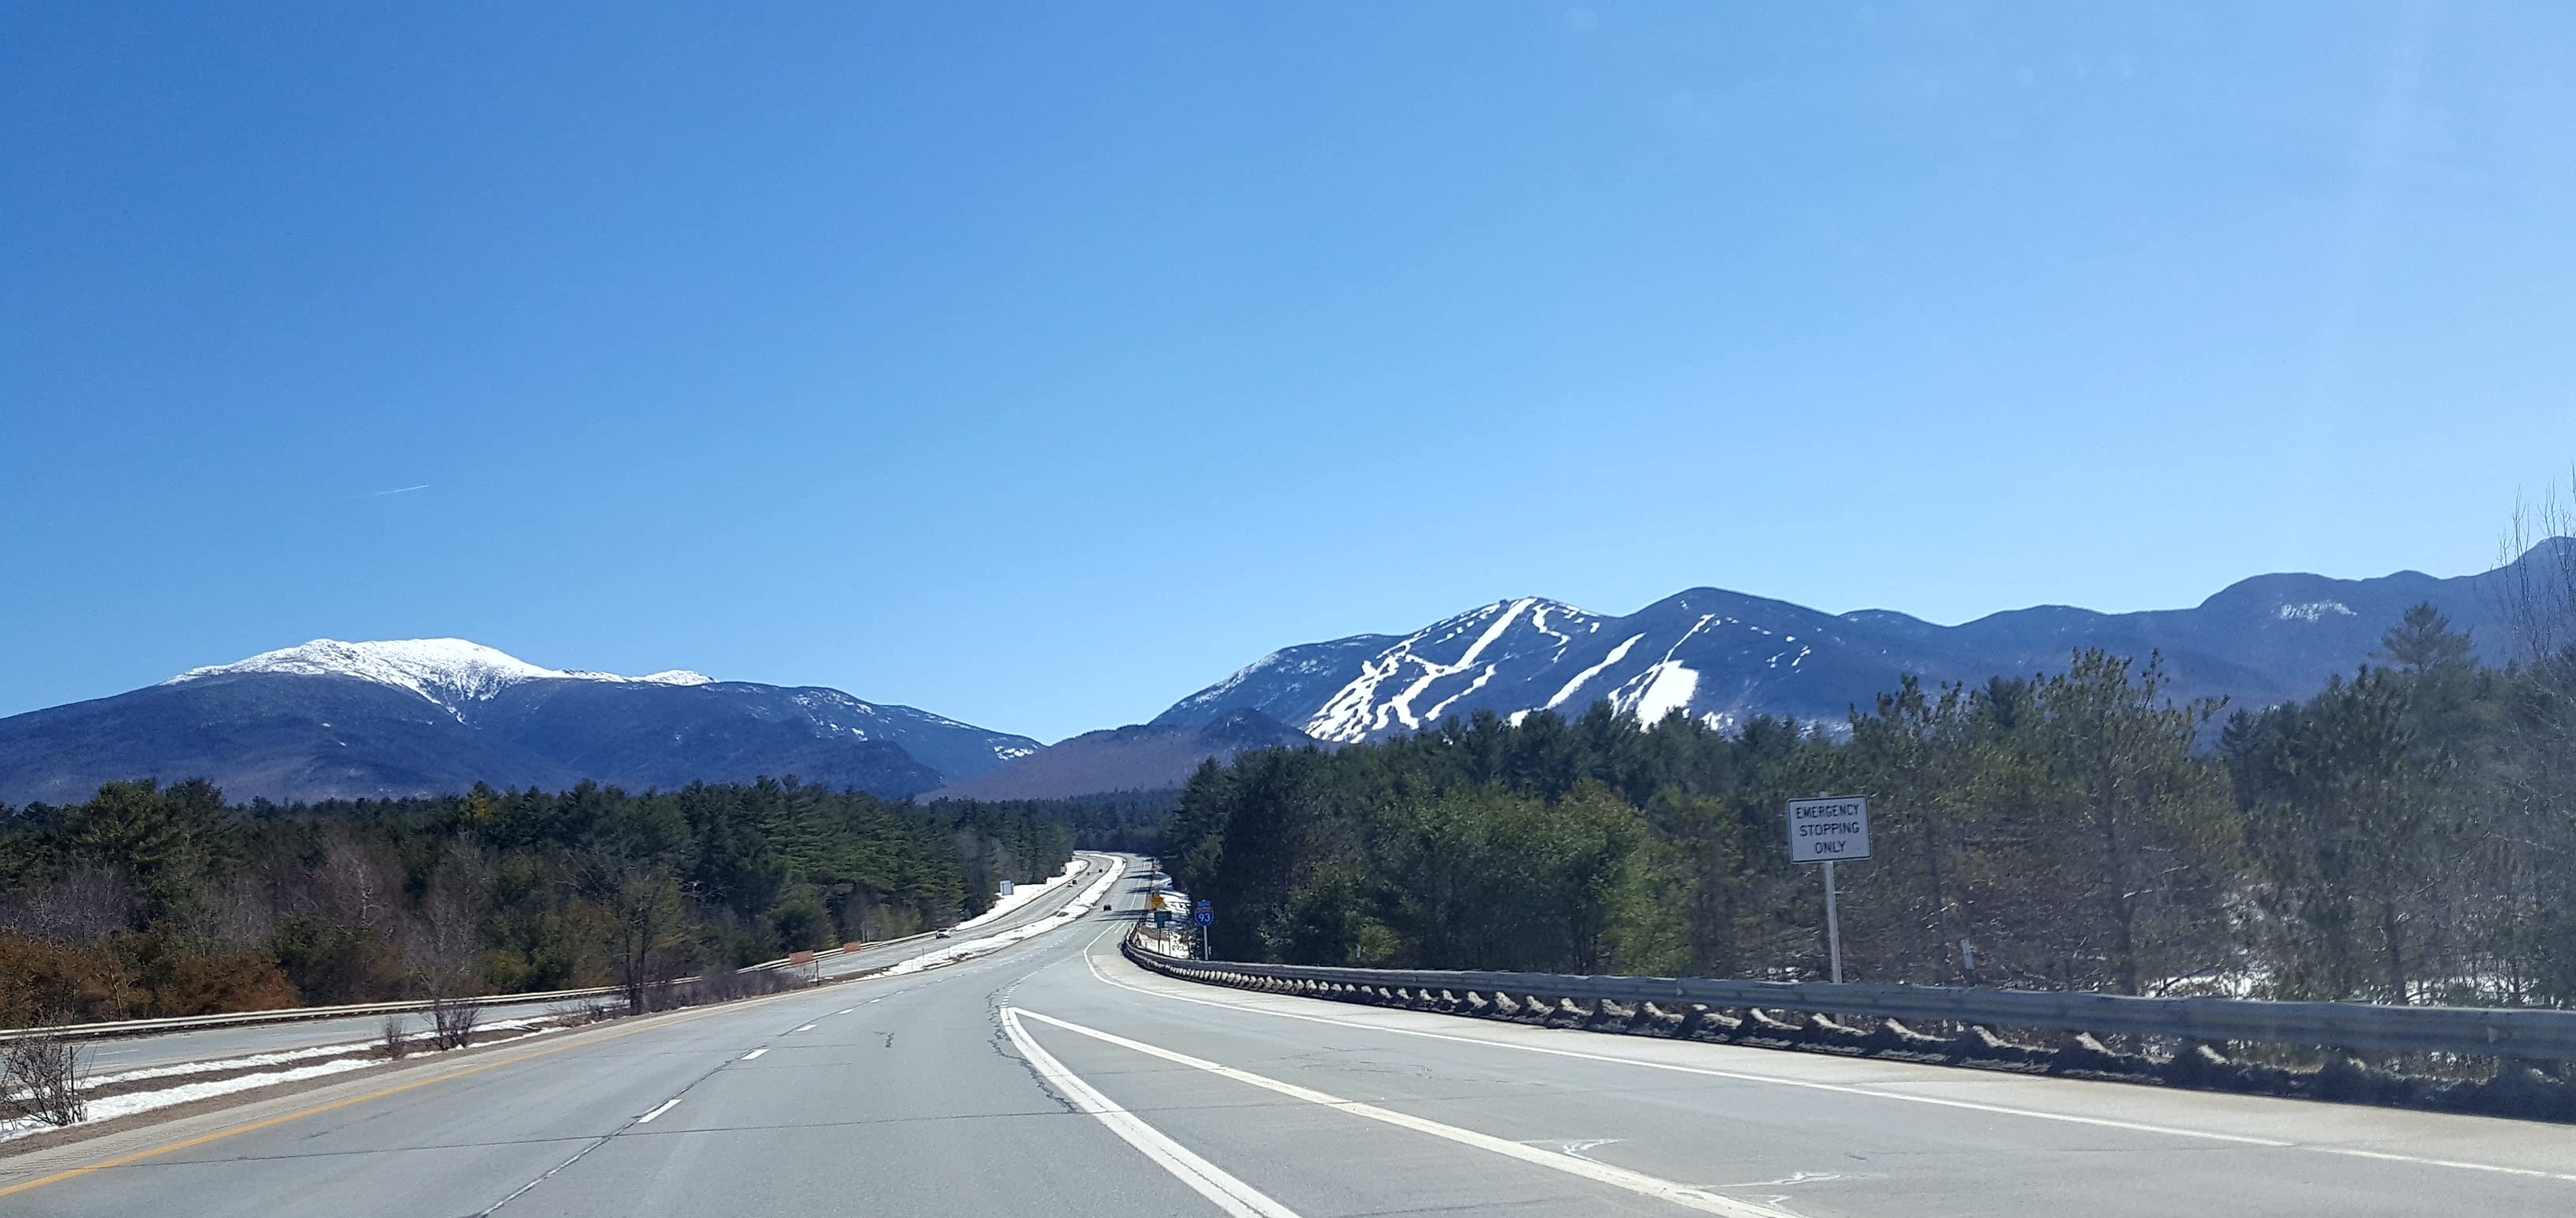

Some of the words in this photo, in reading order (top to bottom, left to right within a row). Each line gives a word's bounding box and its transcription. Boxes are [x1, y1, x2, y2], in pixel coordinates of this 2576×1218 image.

[1796, 804, 1859, 819] EMERGENCY
[1799, 822, 1859, 837] STOPPING
[1815, 841, 1846, 853] ONLY
[1198, 913, 1210, 922] 93
